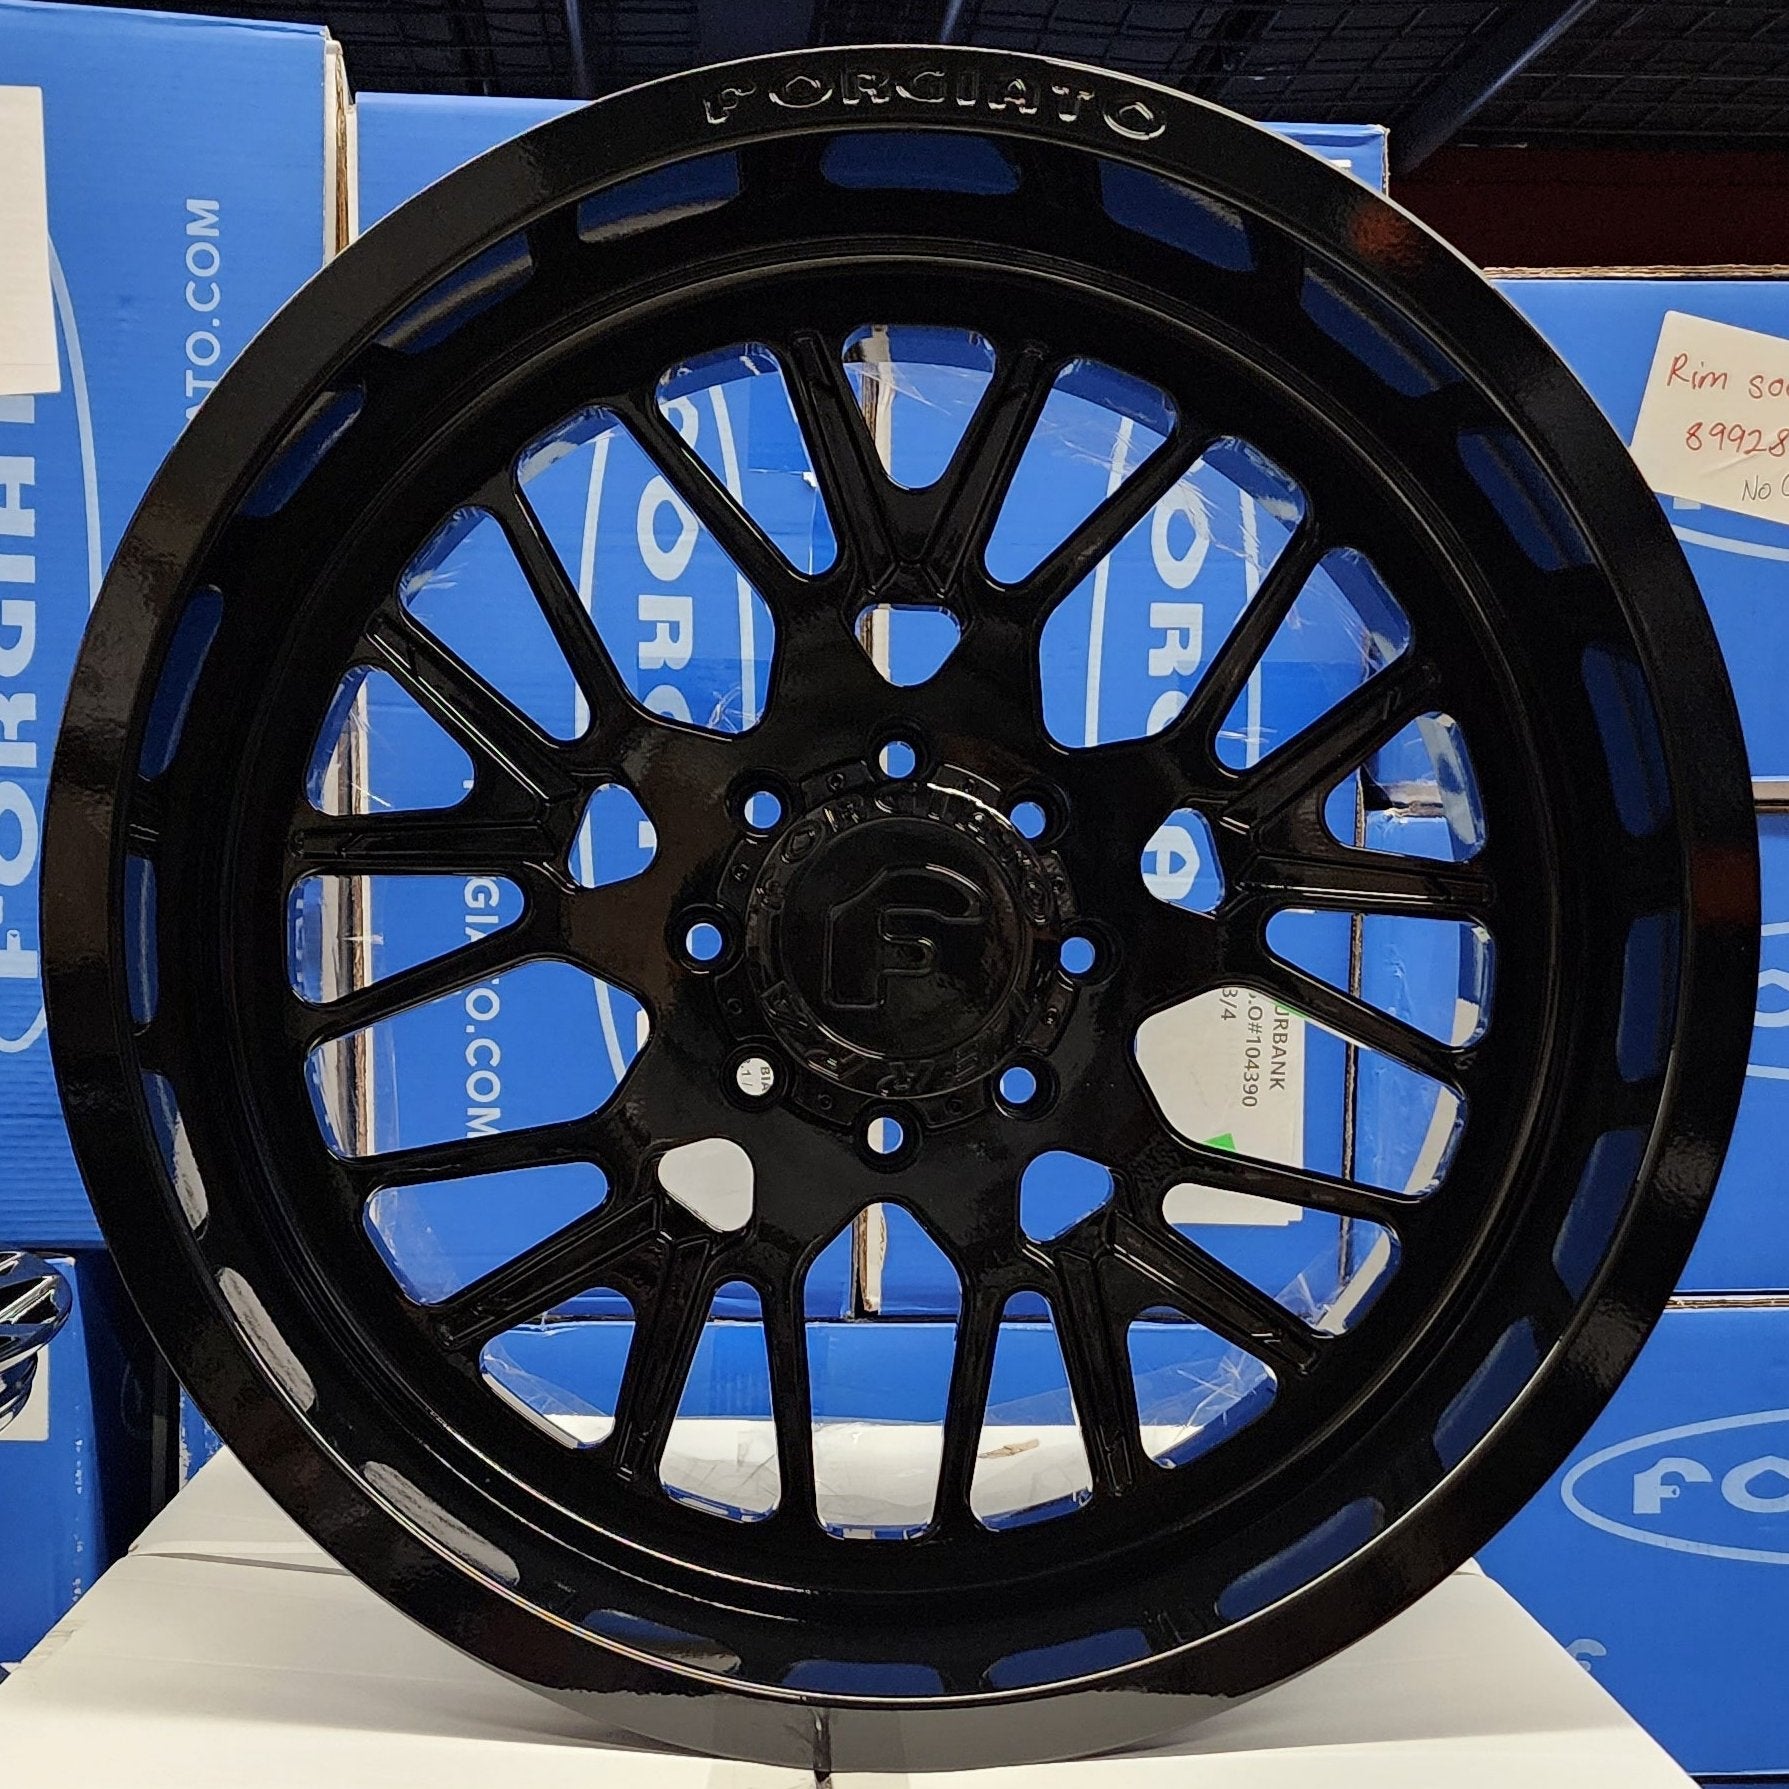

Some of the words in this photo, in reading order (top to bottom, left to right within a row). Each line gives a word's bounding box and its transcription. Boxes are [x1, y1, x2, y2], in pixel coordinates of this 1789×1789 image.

[704, 67, 1166, 141] FORGIATO
[1667, 353, 1728, 390] Rim
[1269, 1004, 1290, 1091] URBANK
